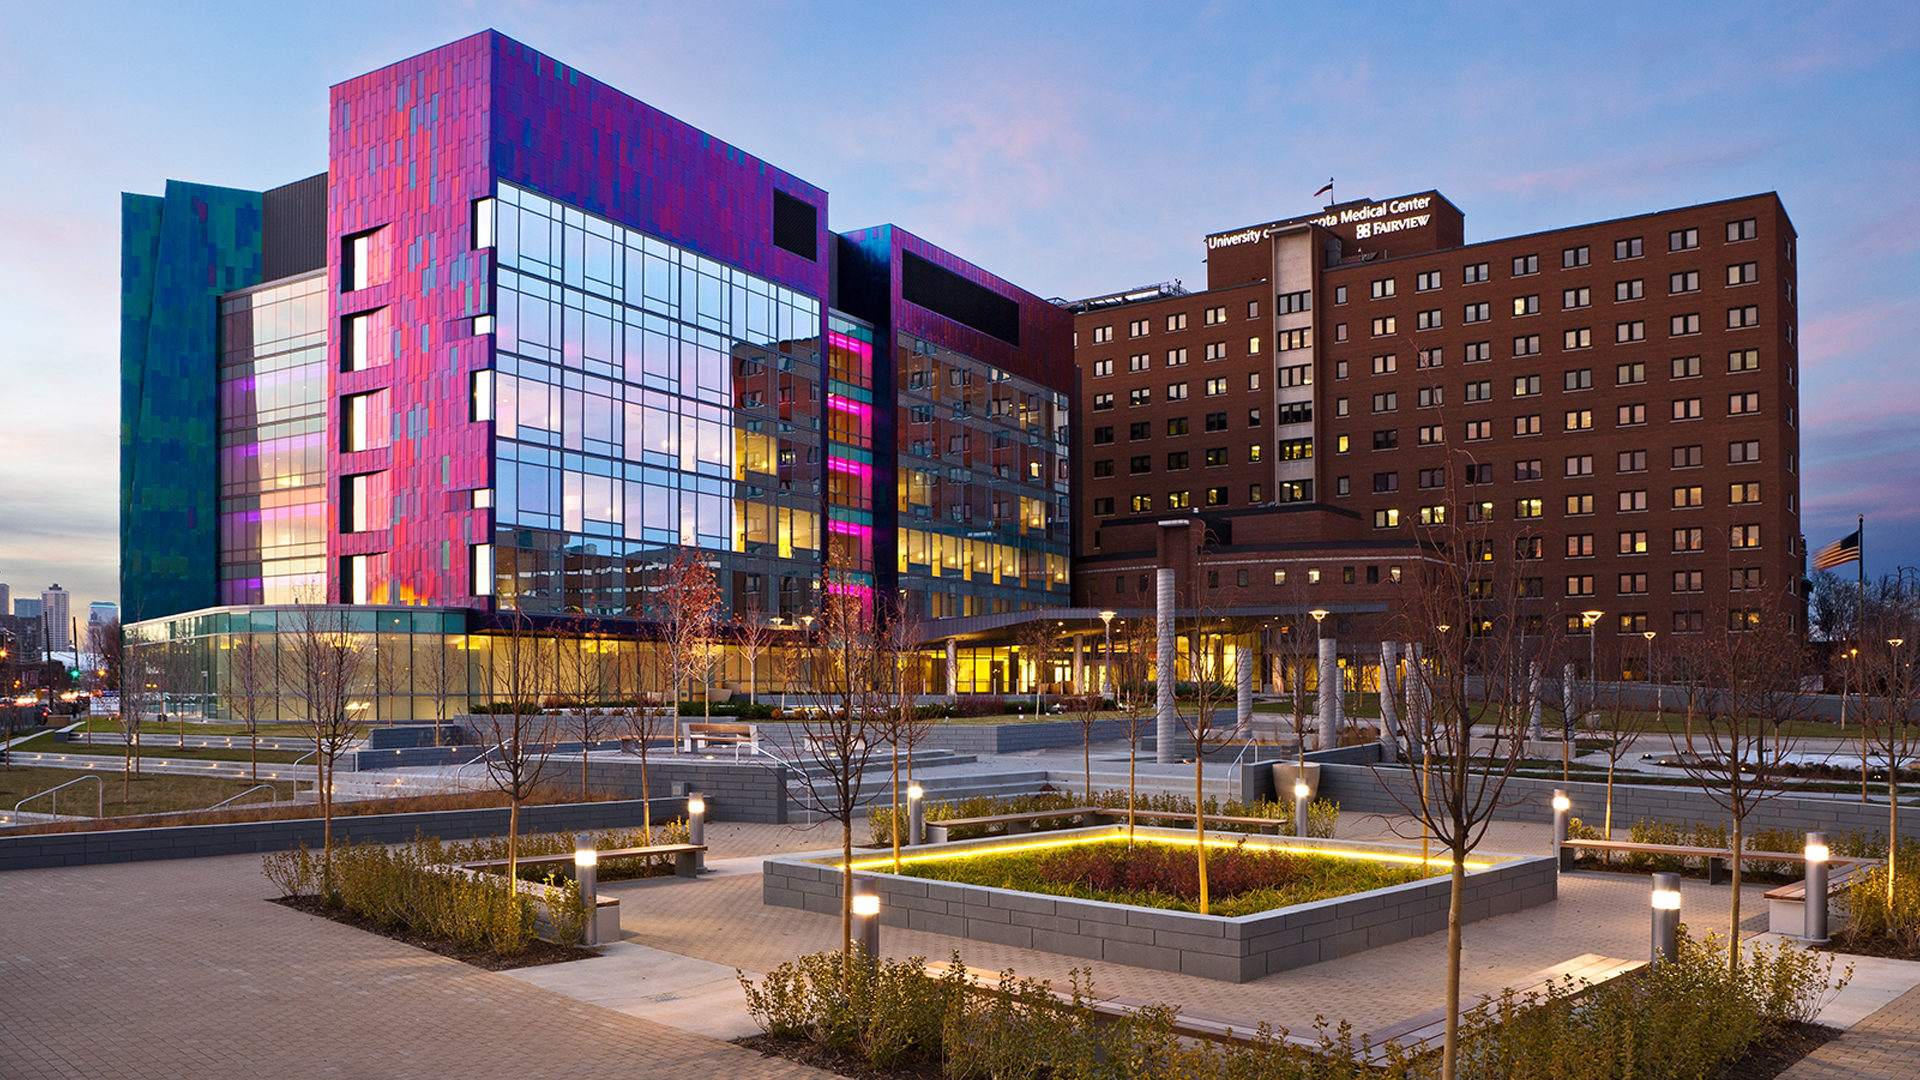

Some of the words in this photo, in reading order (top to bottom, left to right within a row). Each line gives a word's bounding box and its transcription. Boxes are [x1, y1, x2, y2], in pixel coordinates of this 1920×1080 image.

[1208, 229, 1261, 249] University
[1340, 202, 1387, 224] Medical
[1389, 197, 1431, 214] Center
[1372, 214, 1431, 235] FAIRVIEW
